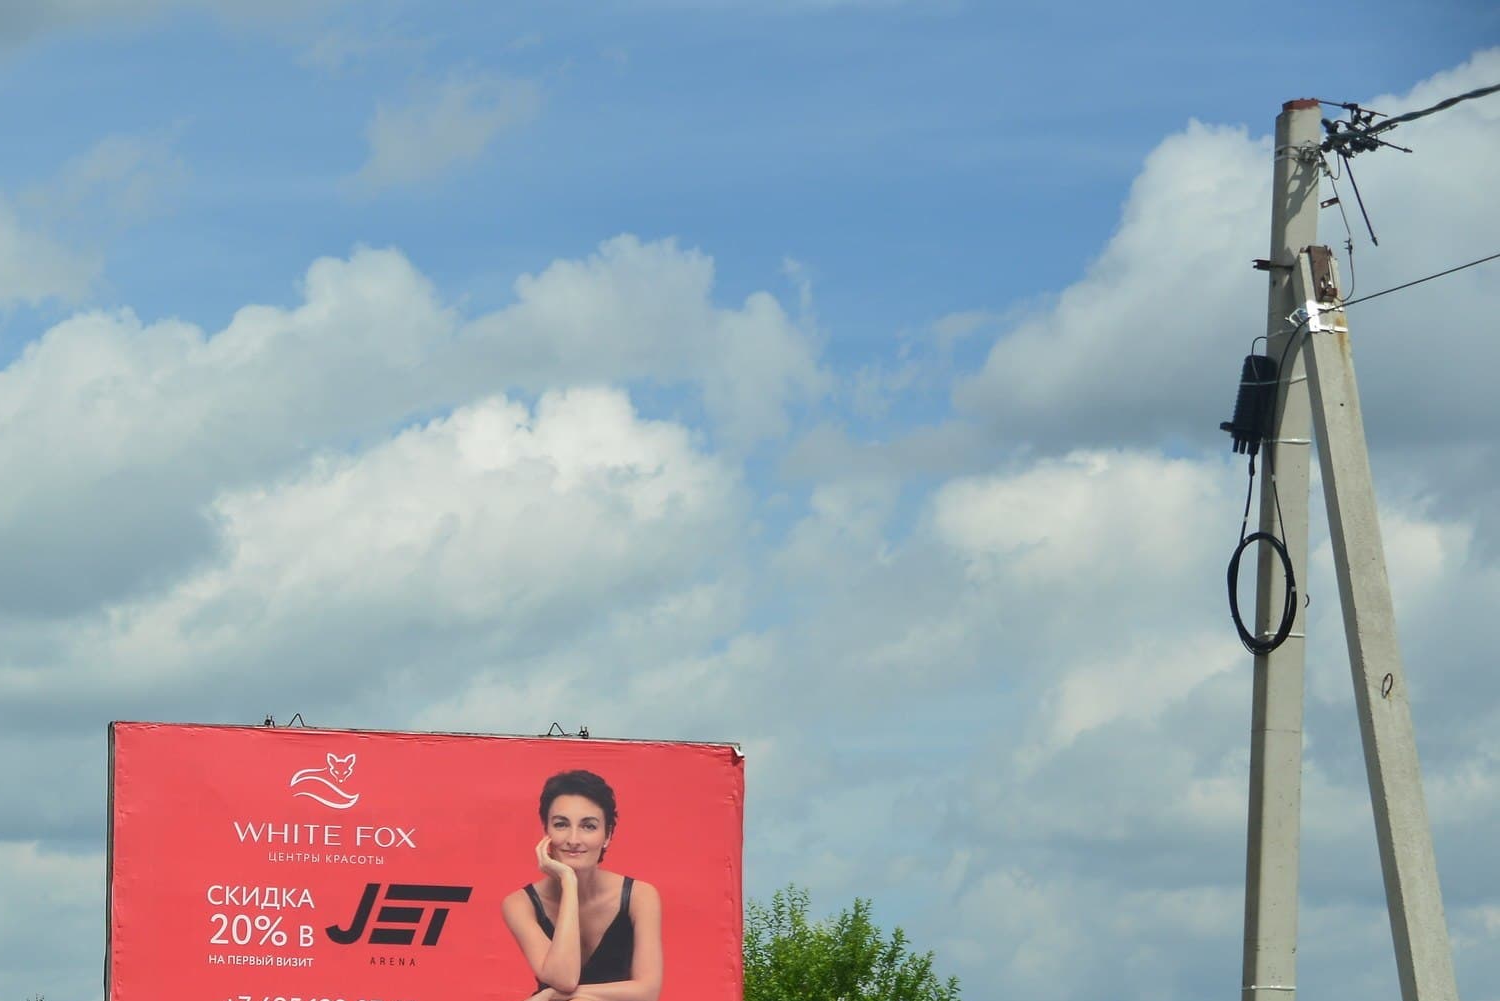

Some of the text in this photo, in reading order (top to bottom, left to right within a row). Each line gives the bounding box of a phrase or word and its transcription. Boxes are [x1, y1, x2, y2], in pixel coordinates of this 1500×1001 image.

[233, 821, 417, 848] WHITE FOX
[268, 852, 384, 865] ЦЕНТРЫ КРАСОТЫ
[207, 885, 315, 909] СКИДКА
[325, 883, 473, 946] JET
[209, 913, 314, 947] 20% В
[208, 954, 314, 967] НА ПЕРВЫЙ ВИЗИТ
[370, 957, 416, 966] ARENA
